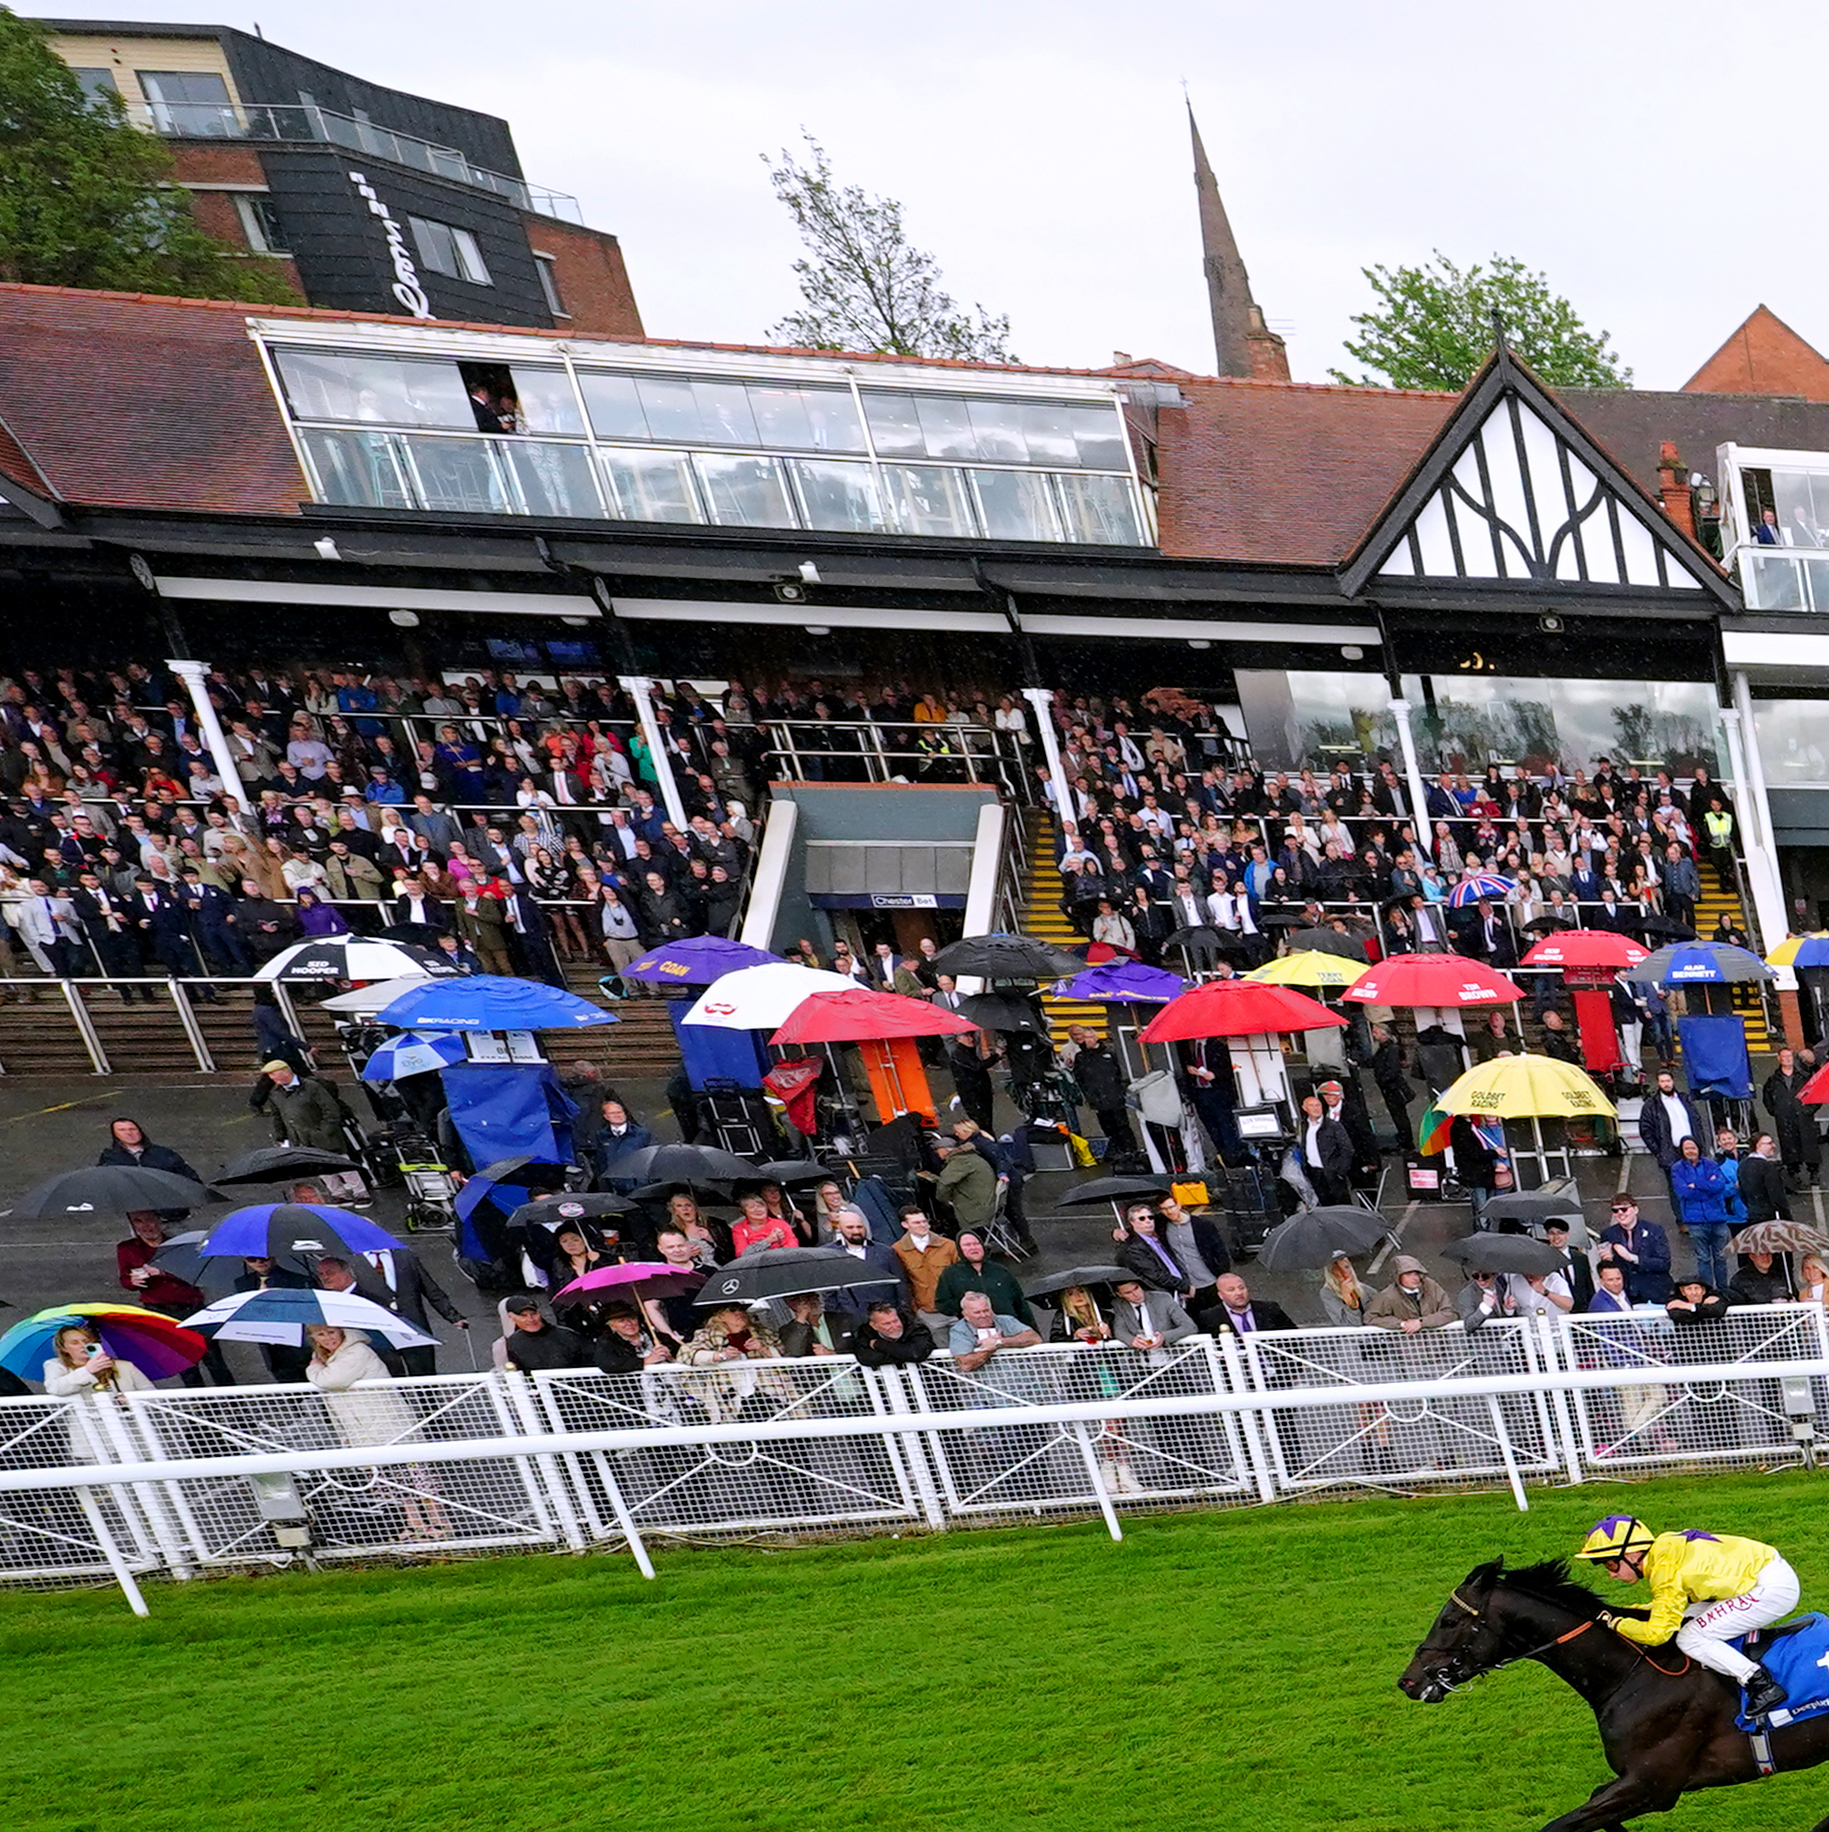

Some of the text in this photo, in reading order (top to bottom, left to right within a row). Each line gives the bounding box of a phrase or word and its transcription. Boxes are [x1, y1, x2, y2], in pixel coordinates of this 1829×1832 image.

[874, 896, 934, 905] Chester Bet
[307, 960, 330, 968] SID
[291, 966, 340, 975] HOOPER
[1671, 970, 1717, 978] BENNETT
[1458, 988, 1499, 1001] BROWN
[1471, 1090, 1507, 1101] GOLDBET
[1470, 1099, 1501, 1109] RACING
[1569, 1100, 1597, 1108] RACING
